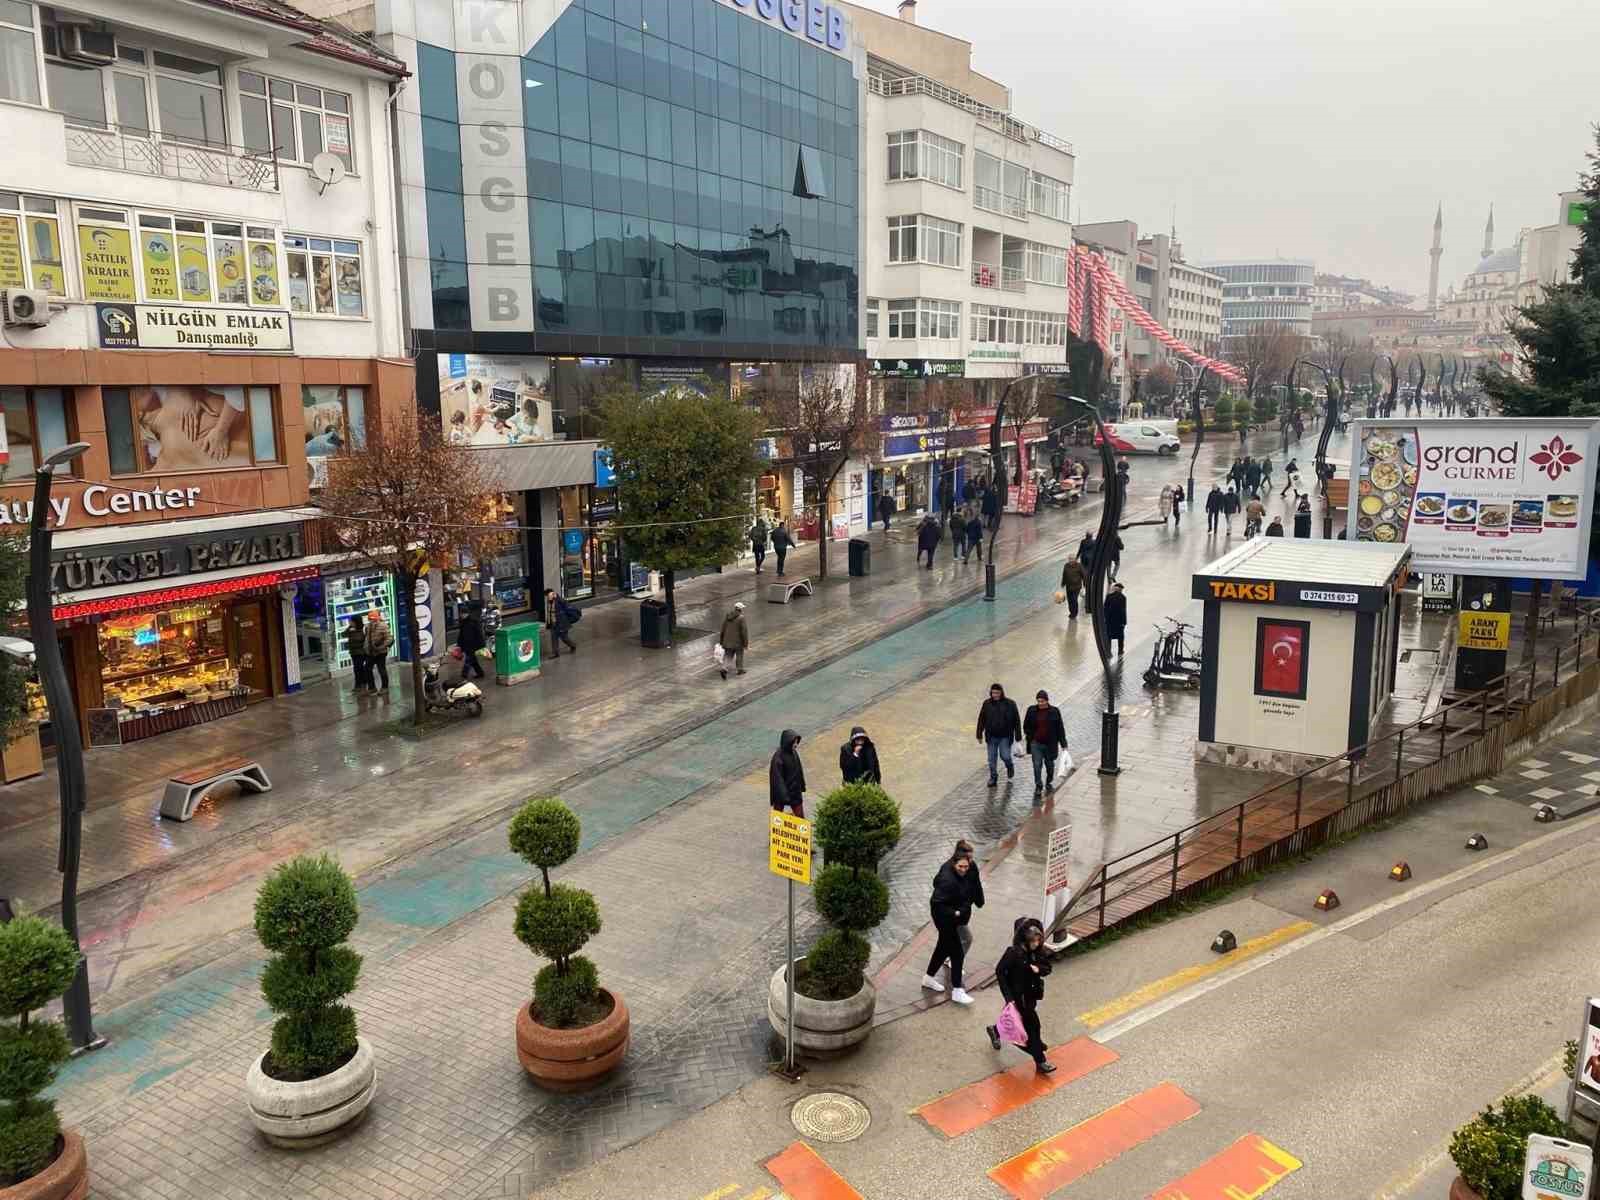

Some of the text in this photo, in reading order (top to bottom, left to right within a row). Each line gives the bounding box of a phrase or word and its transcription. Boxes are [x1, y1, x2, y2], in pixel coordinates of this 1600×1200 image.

[469, 0, 522, 322] KOSGEB
[86, 252, 127, 265] SATILIK
[146, 308, 283, 330] NİLGÜN EMLAK
[177, 330, 259, 347] Danışmanlığı
[1424, 441, 1519, 471] grand
[1444, 467, 1516, 480] GURME
[0, 485, 201, 527] auy Center
[49, 532, 299, 590] YÜKSEL PAZARI
[1209, 581, 1276, 601] TAKSİ
